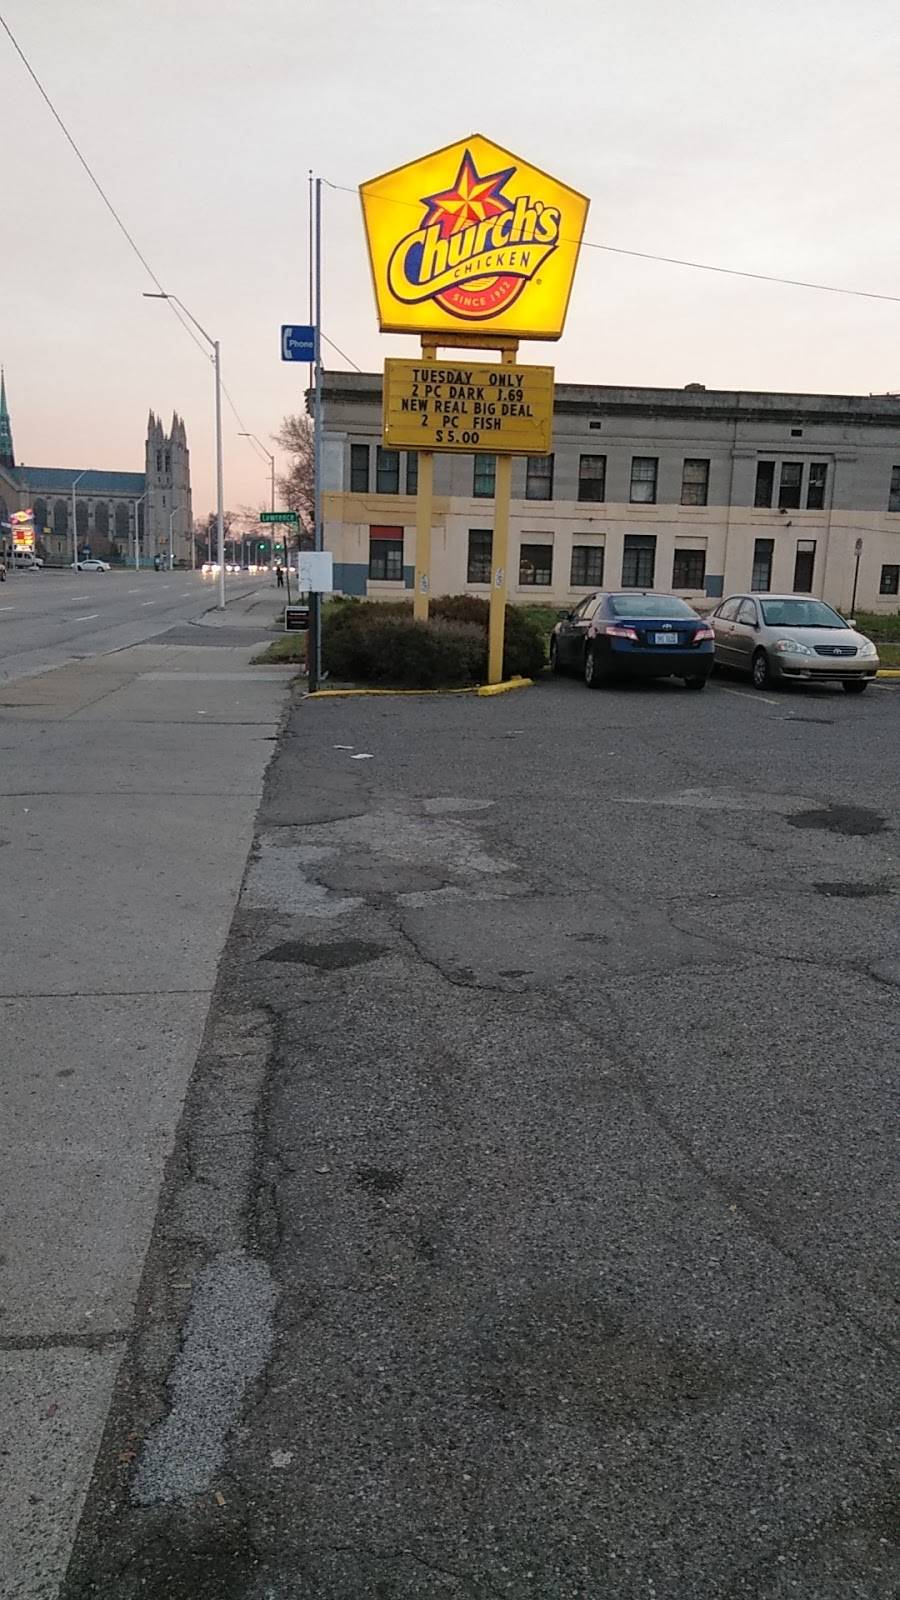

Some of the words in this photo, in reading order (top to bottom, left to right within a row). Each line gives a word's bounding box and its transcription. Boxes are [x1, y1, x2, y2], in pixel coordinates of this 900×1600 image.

[388, 196, 561, 306] Church's
[454, 250, 531, 279] CHICKEN
[452, 293, 487, 307] SINCE
[490, 281, 512, 302] 1952
[290, 339, 313, 348] Phone
[412, 369, 473, 385] TUESDAY
[489, 373, 524, 388] ONLY
[411, 384, 419, 397] 2
[425, 385, 441, 398] PC
[449, 386, 484, 400] DARK
[402, 398, 428, 411] NEW
[434, 400, 468, 414] REAL
[474, 402, 496, 415] BIG
[501, 403, 533, 417] DEAL
[421, 414, 428, 426] 2
[442, 415, 459, 428] PC
[473, 417, 502, 430] FISH
